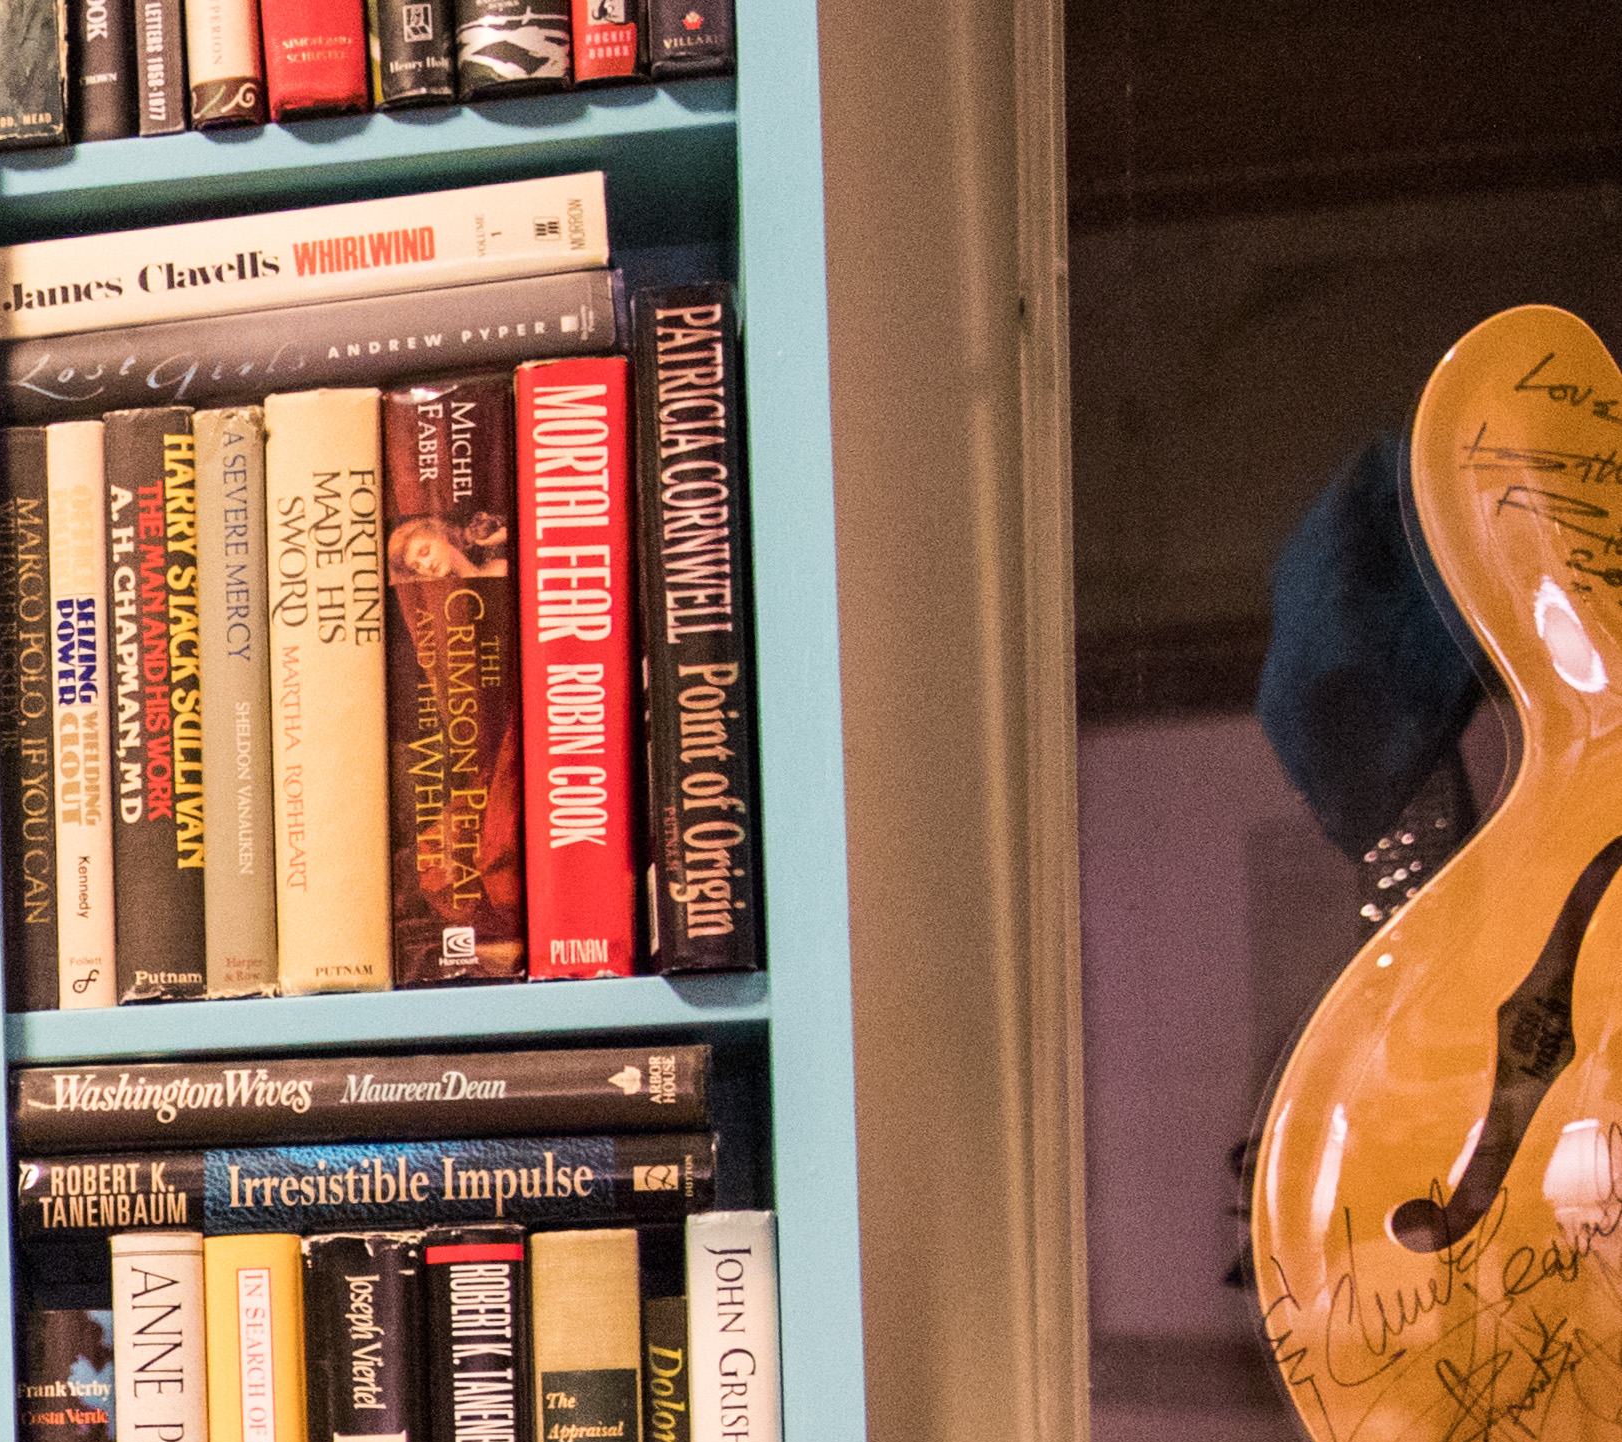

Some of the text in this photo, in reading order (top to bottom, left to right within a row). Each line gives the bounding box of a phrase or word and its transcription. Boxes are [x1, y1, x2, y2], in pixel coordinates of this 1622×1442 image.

[2, 226, 436, 315] James Clavell's WHIRLWIND
[326, 320, 547, 361] ANDREW PYPER
[656, 303, 733, 644] PATRICIA CORNWELL
[271, 498, 308, 628] SWORD
[307, 472, 346, 644] MADE HIS
[344, 468, 381, 646] FORTUNE
[533, 384, 612, 849] MORTAL FEAR ROBIN COOK
[669, 662, 747, 939] Point of Origin
[77, 856, 90, 919] Kennedy
[550, 940, 608, 964] PUTNAM
[40, 1192, 186, 1228] TANENBAUM
[50, 1162, 175, 1196] ROBERT K.
[229, 1151, 593, 1216] Irresistible Impulse
[244, 1274, 263, 1296] IN
[703, 1246, 752, 1333] JOHN
[131, 1267, 184, 1398] ANNE
[245, 1306, 267, 1397] SEARCH
[248, 1408, 268, 1435] OF
